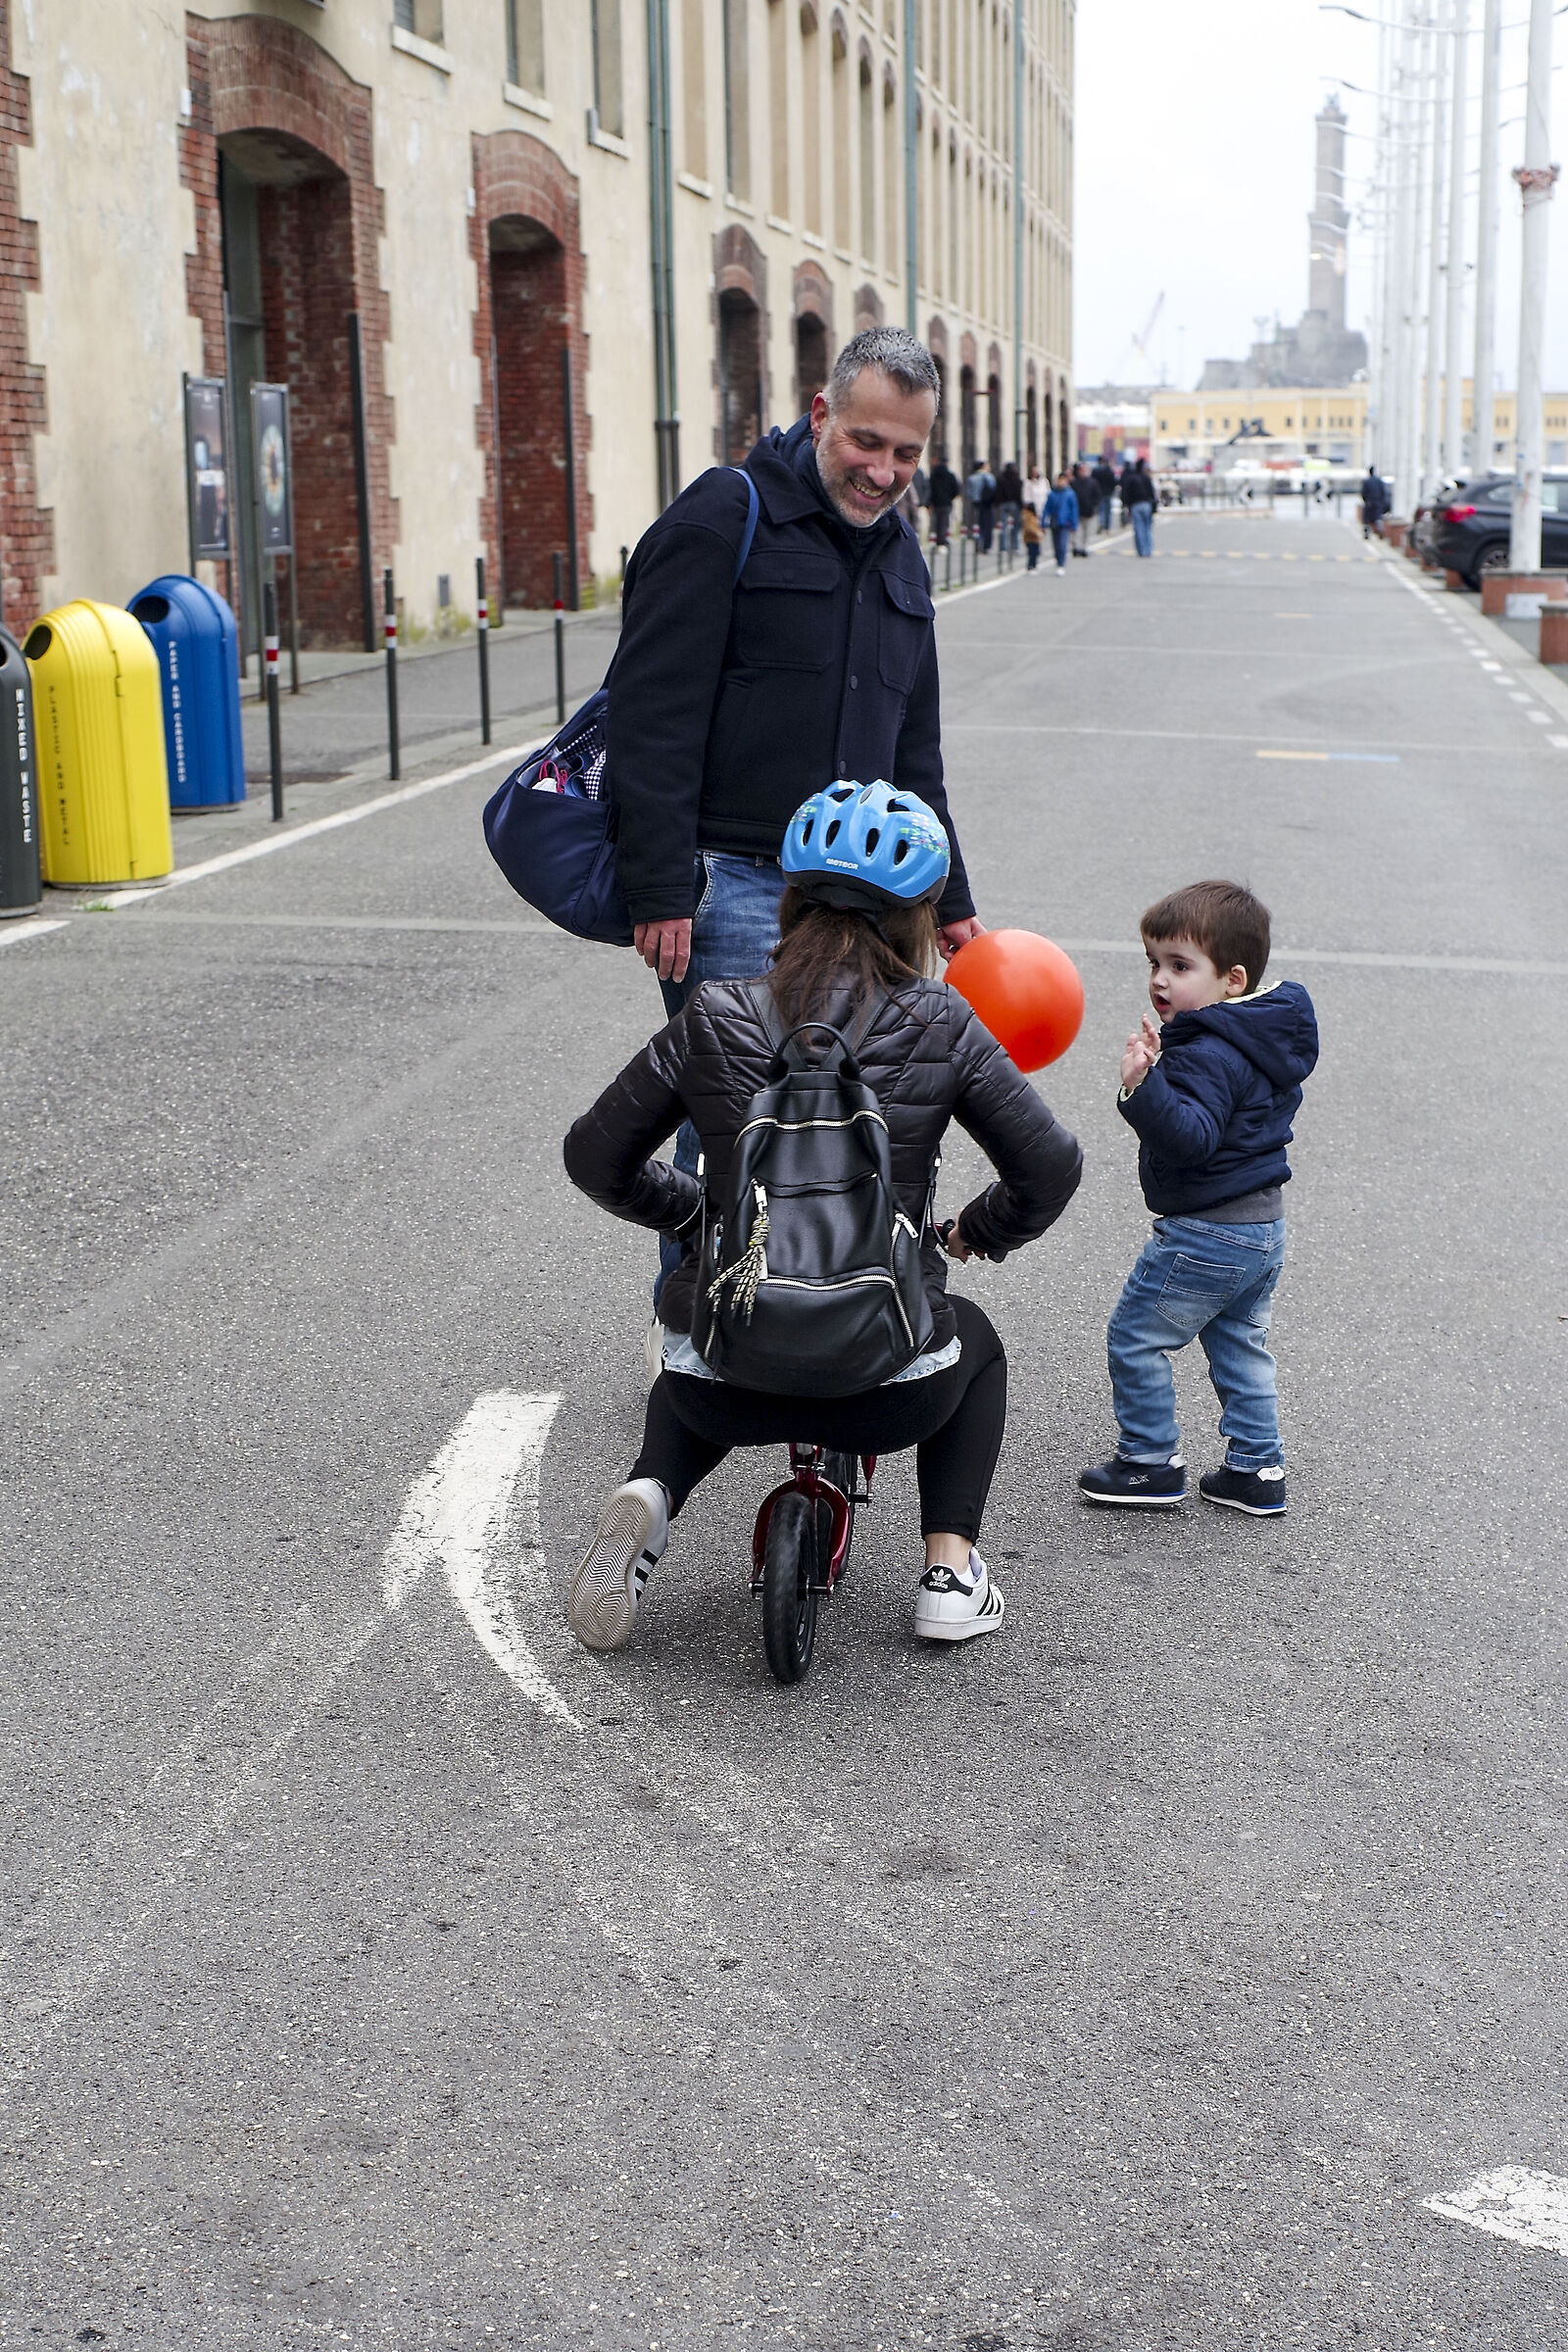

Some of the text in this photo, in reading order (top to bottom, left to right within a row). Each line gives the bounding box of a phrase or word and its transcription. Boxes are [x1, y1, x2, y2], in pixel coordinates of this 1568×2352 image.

[16, 688, 32, 844] MIXED WASTE
[169, 640, 186, 783] PAPER AND CARDBOARD
[825, 858, 858, 870] METEOR
